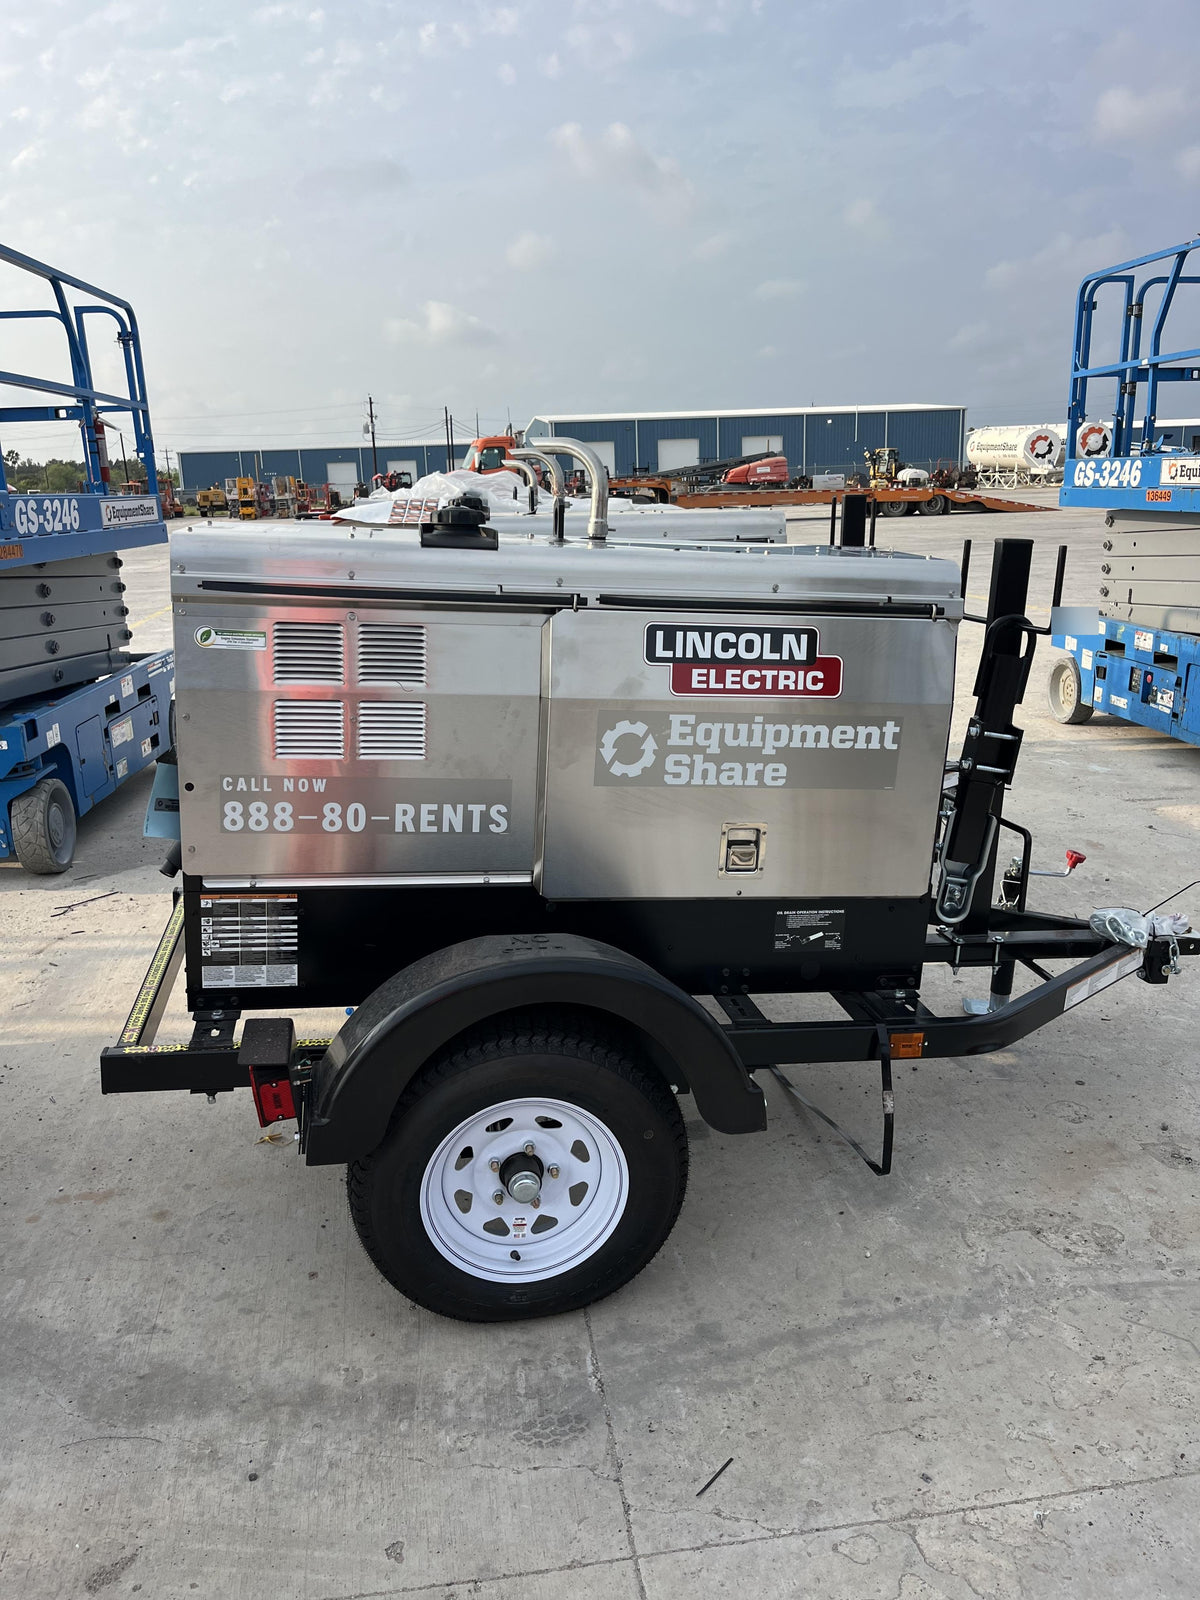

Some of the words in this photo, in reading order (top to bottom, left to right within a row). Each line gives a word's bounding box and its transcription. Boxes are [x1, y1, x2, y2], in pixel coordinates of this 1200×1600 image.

[1074, 460, 1142, 487] GS-3246
[1147, 491, 1171, 501] 136449
[15, 499, 80, 534] GS-3246
[112, 504, 155, 521] EquipmentShare
[655, 630, 808, 661] LINCOLN
[691, 668, 824, 691] ELECTRIC
[667, 714, 900, 755] Equipment
[223, 777, 272, 792] CALL
[283, 778, 327, 793] NOW
[664, 754, 788, 787] Share
[223, 801, 508, 833] 888-80-RENTS
